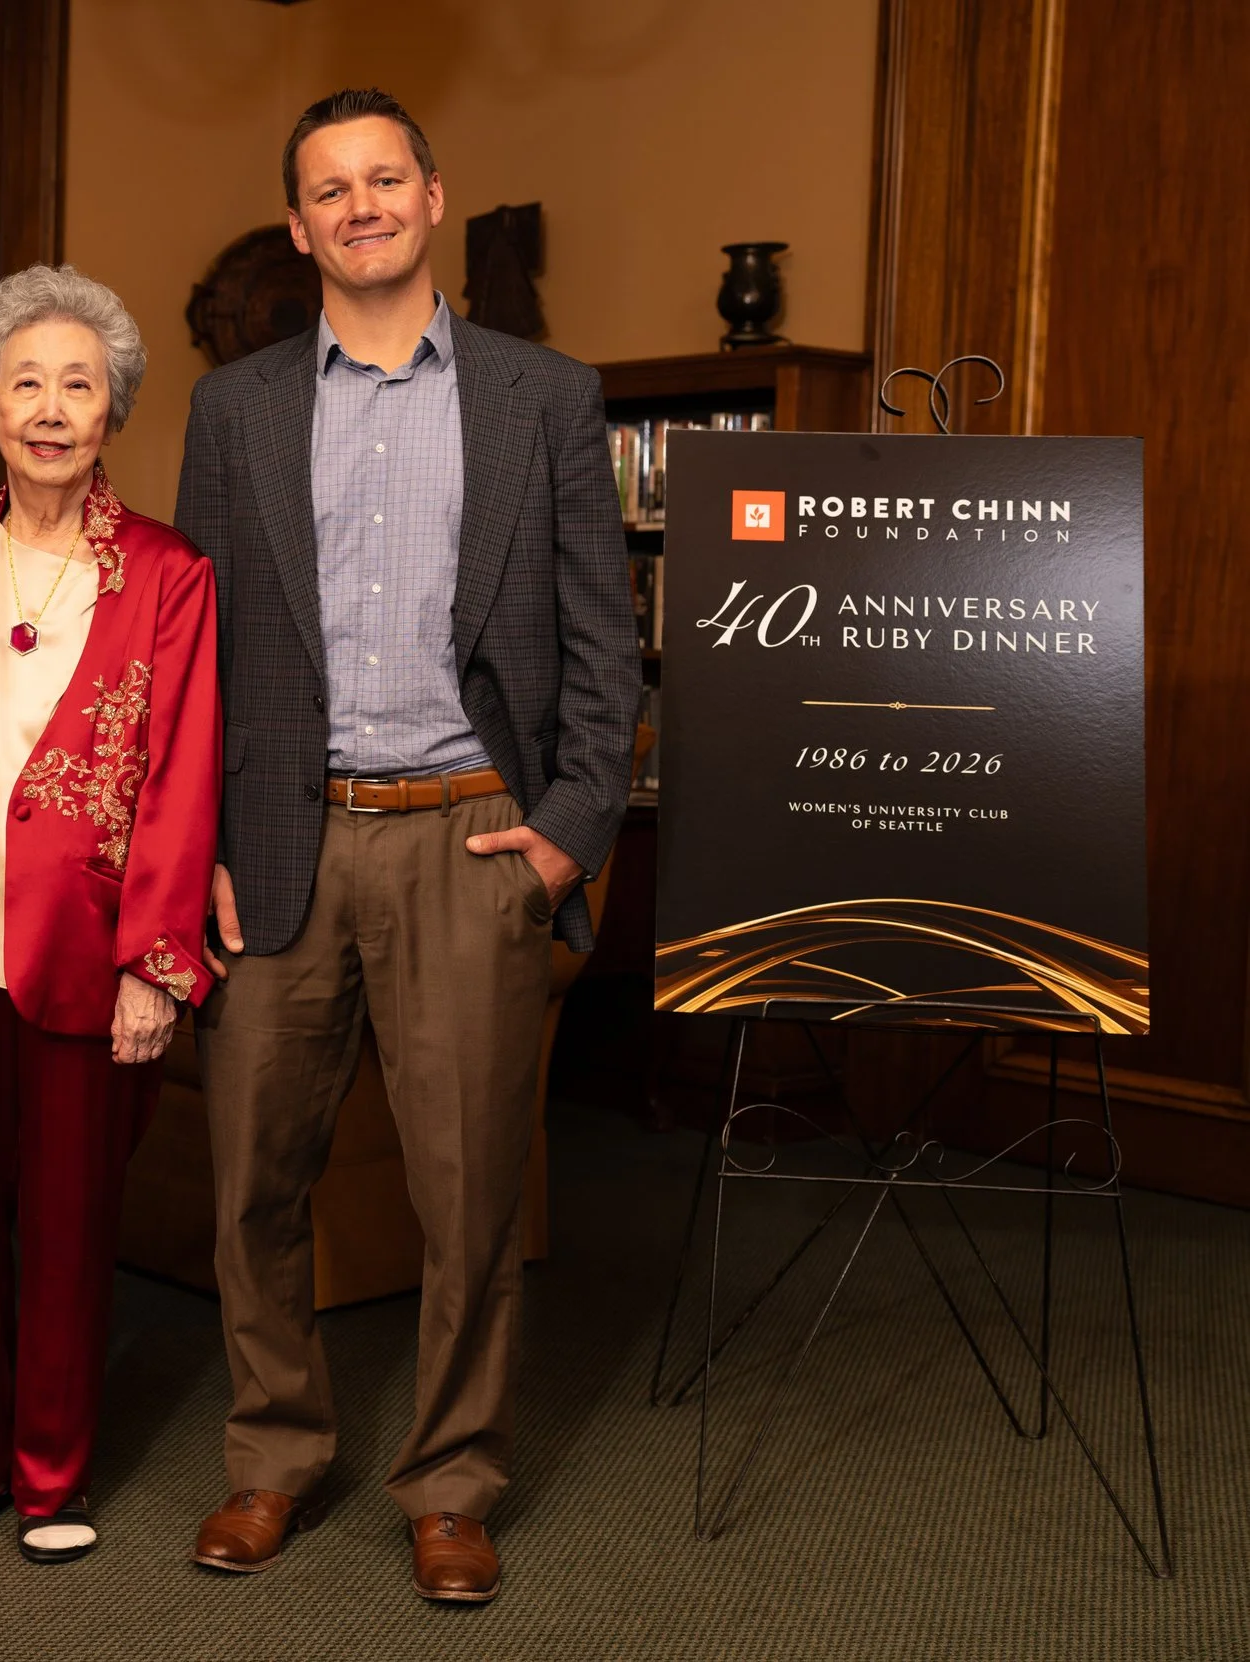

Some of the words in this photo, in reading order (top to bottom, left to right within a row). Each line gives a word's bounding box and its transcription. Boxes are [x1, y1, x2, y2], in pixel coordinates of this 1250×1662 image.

[798, 495, 936, 520] ROBERT
[951, 499, 1071, 522] CHINN
[798, 524, 1070, 544] FOUNDATION
[838, 594, 1100, 622] ANNIVERSARY
[842, 626, 932, 650] RUBY
[953, 629, 1097, 655] DINNER
[795, 746, 869, 770] 1986
[879, 752, 909, 772] to
[919, 751, 1004, 775] 2026
[788, 802, 861, 814] WOMEN'S
[868, 804, 962, 818] UNIVERSITY
[968, 808, 1009, 820] CLUB
[851, 819, 872, 829] OF
[879, 820, 944, 832] SEATTLE
